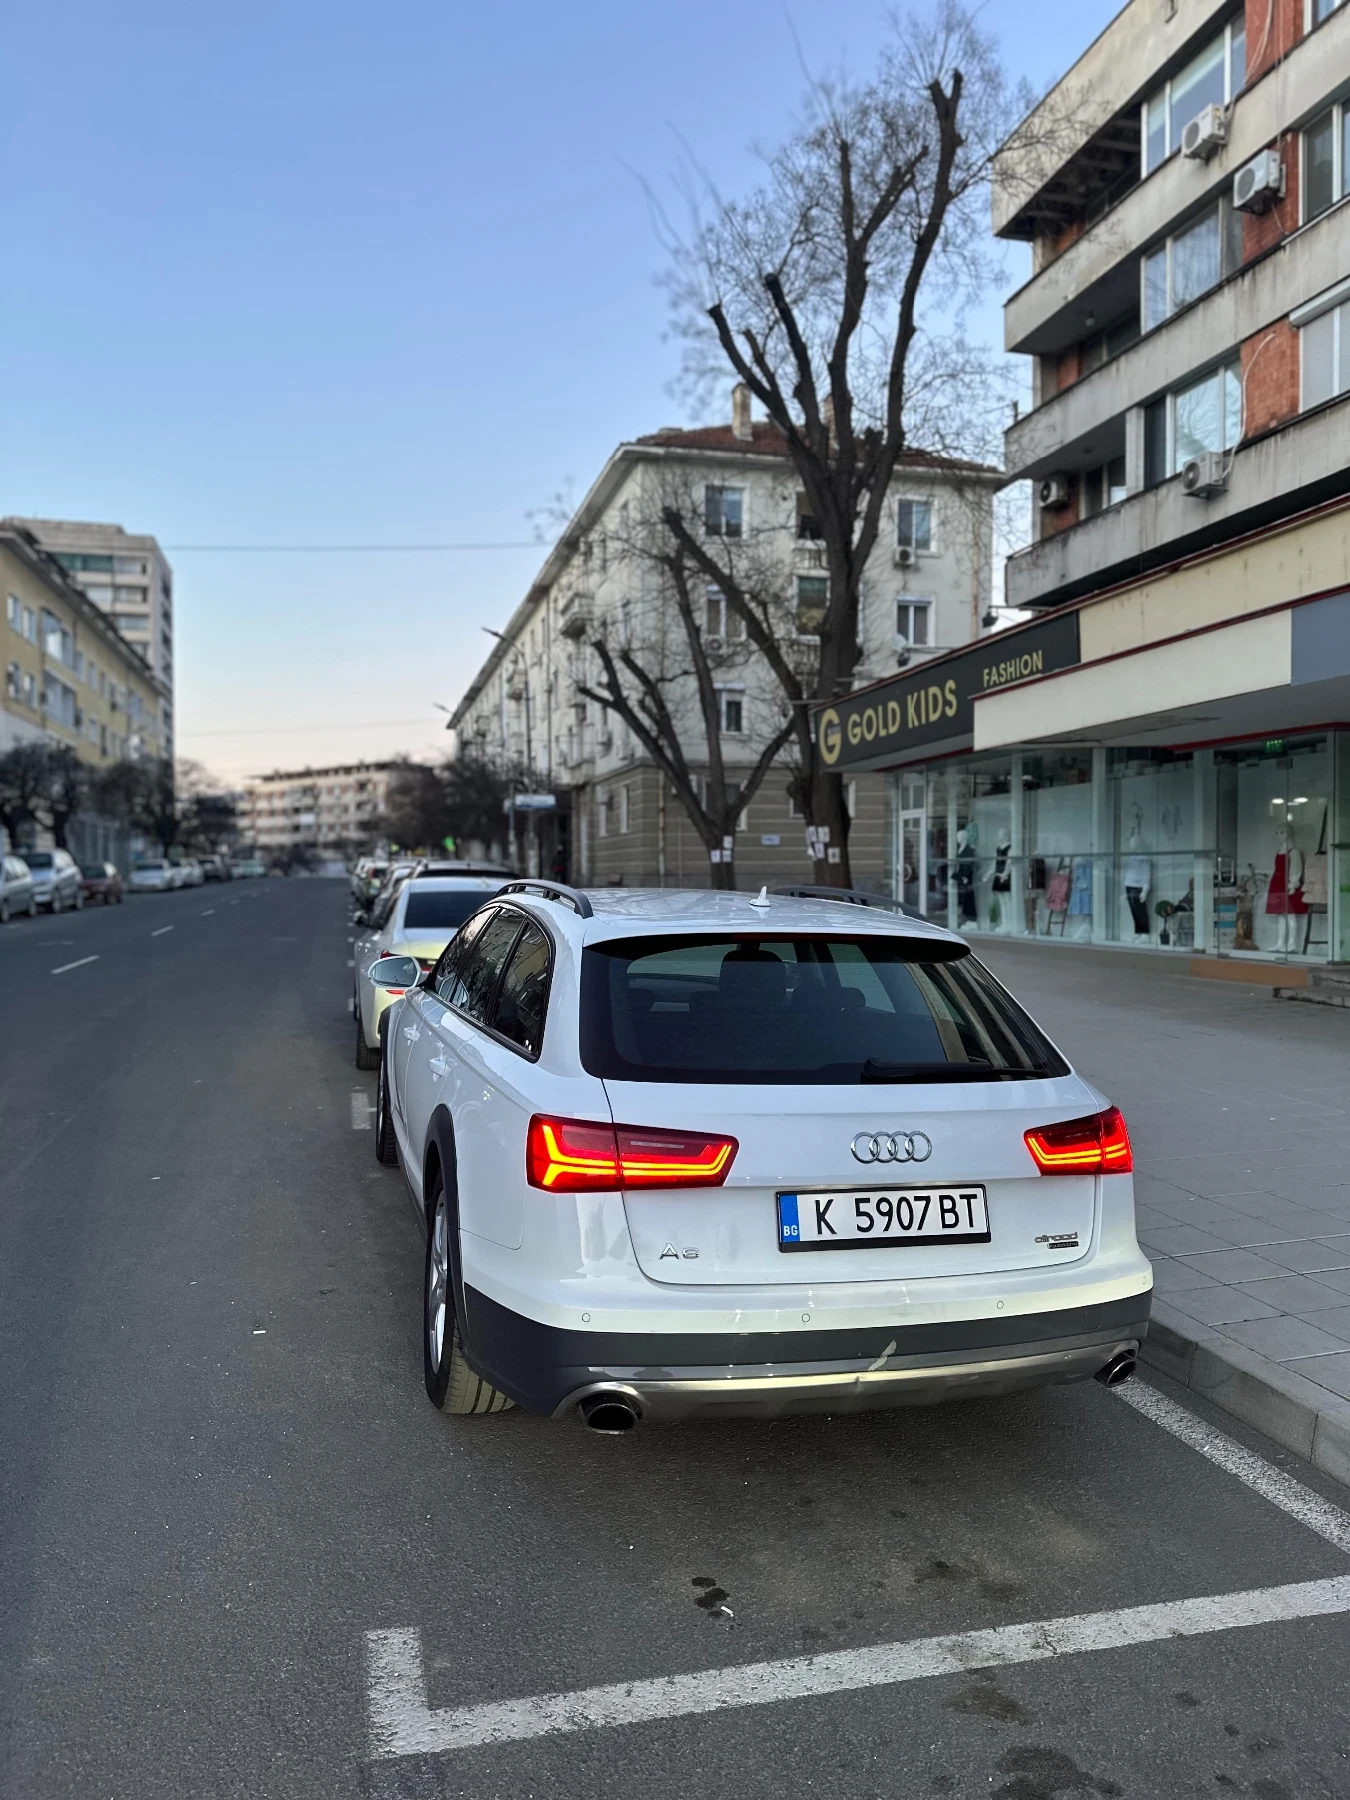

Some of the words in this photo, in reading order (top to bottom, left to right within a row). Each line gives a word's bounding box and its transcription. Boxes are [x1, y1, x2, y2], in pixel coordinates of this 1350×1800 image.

[983, 650, 1043, 687] FASHION
[848, 701, 900, 745] GOLD
[907, 680, 957, 729] KIDS
[819, 708, 842, 765] G
[783, 1225, 798, 1236] BG
[815, 1199, 838, 1235] K
[854, 1196, 931, 1233] 5907
[938, 1194, 978, 1229] BT
[659, 1243, 699, 1260] A6
